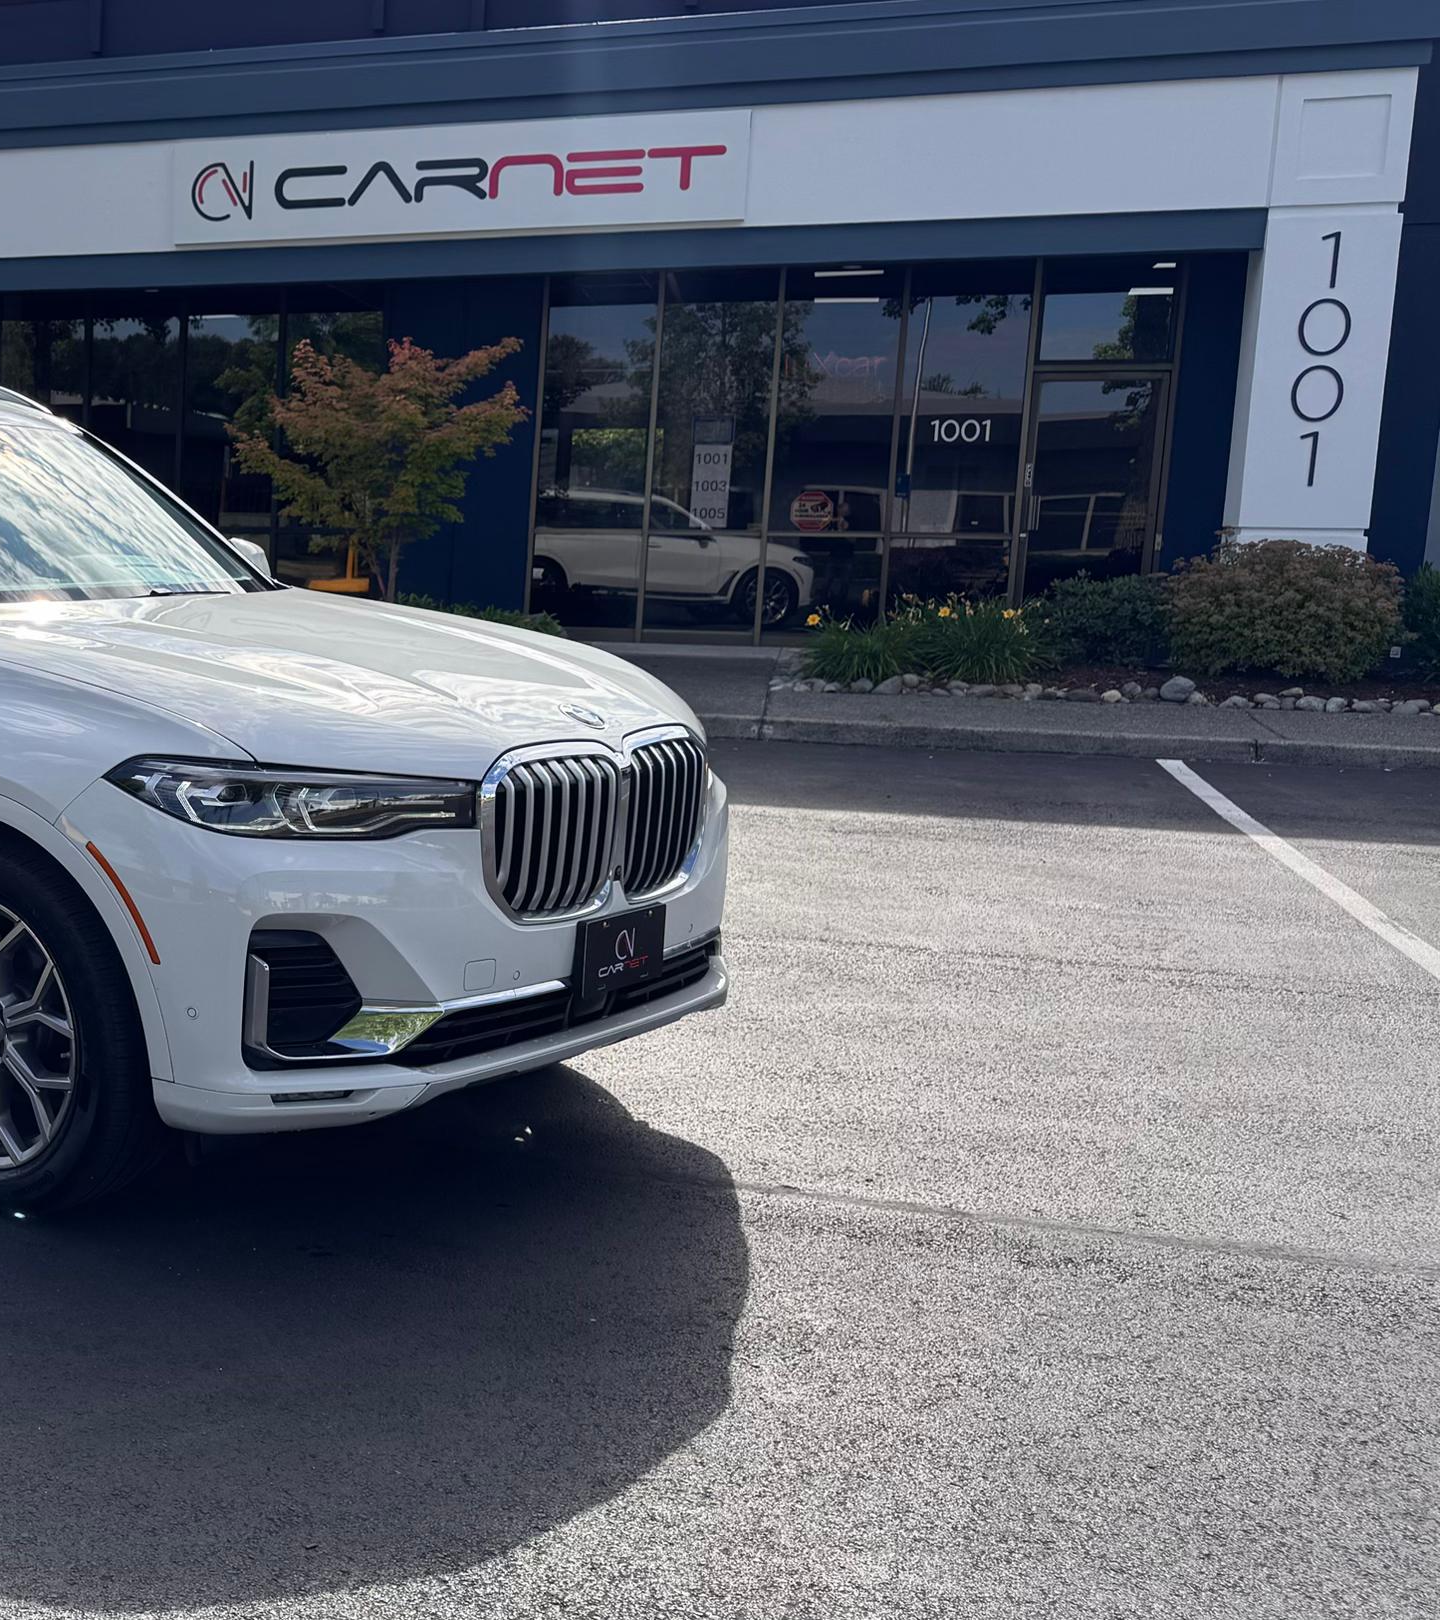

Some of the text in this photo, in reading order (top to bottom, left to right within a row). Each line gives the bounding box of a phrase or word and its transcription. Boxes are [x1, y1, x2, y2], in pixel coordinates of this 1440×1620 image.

[274, 144, 728, 210] CARNET
[1290, 231, 1352, 488] 1001
[930, 418, 992, 442] 1001
[695, 452, 728, 465] 1001
[693, 480, 728, 492] 1003
[691, 507, 726, 520] 1005
